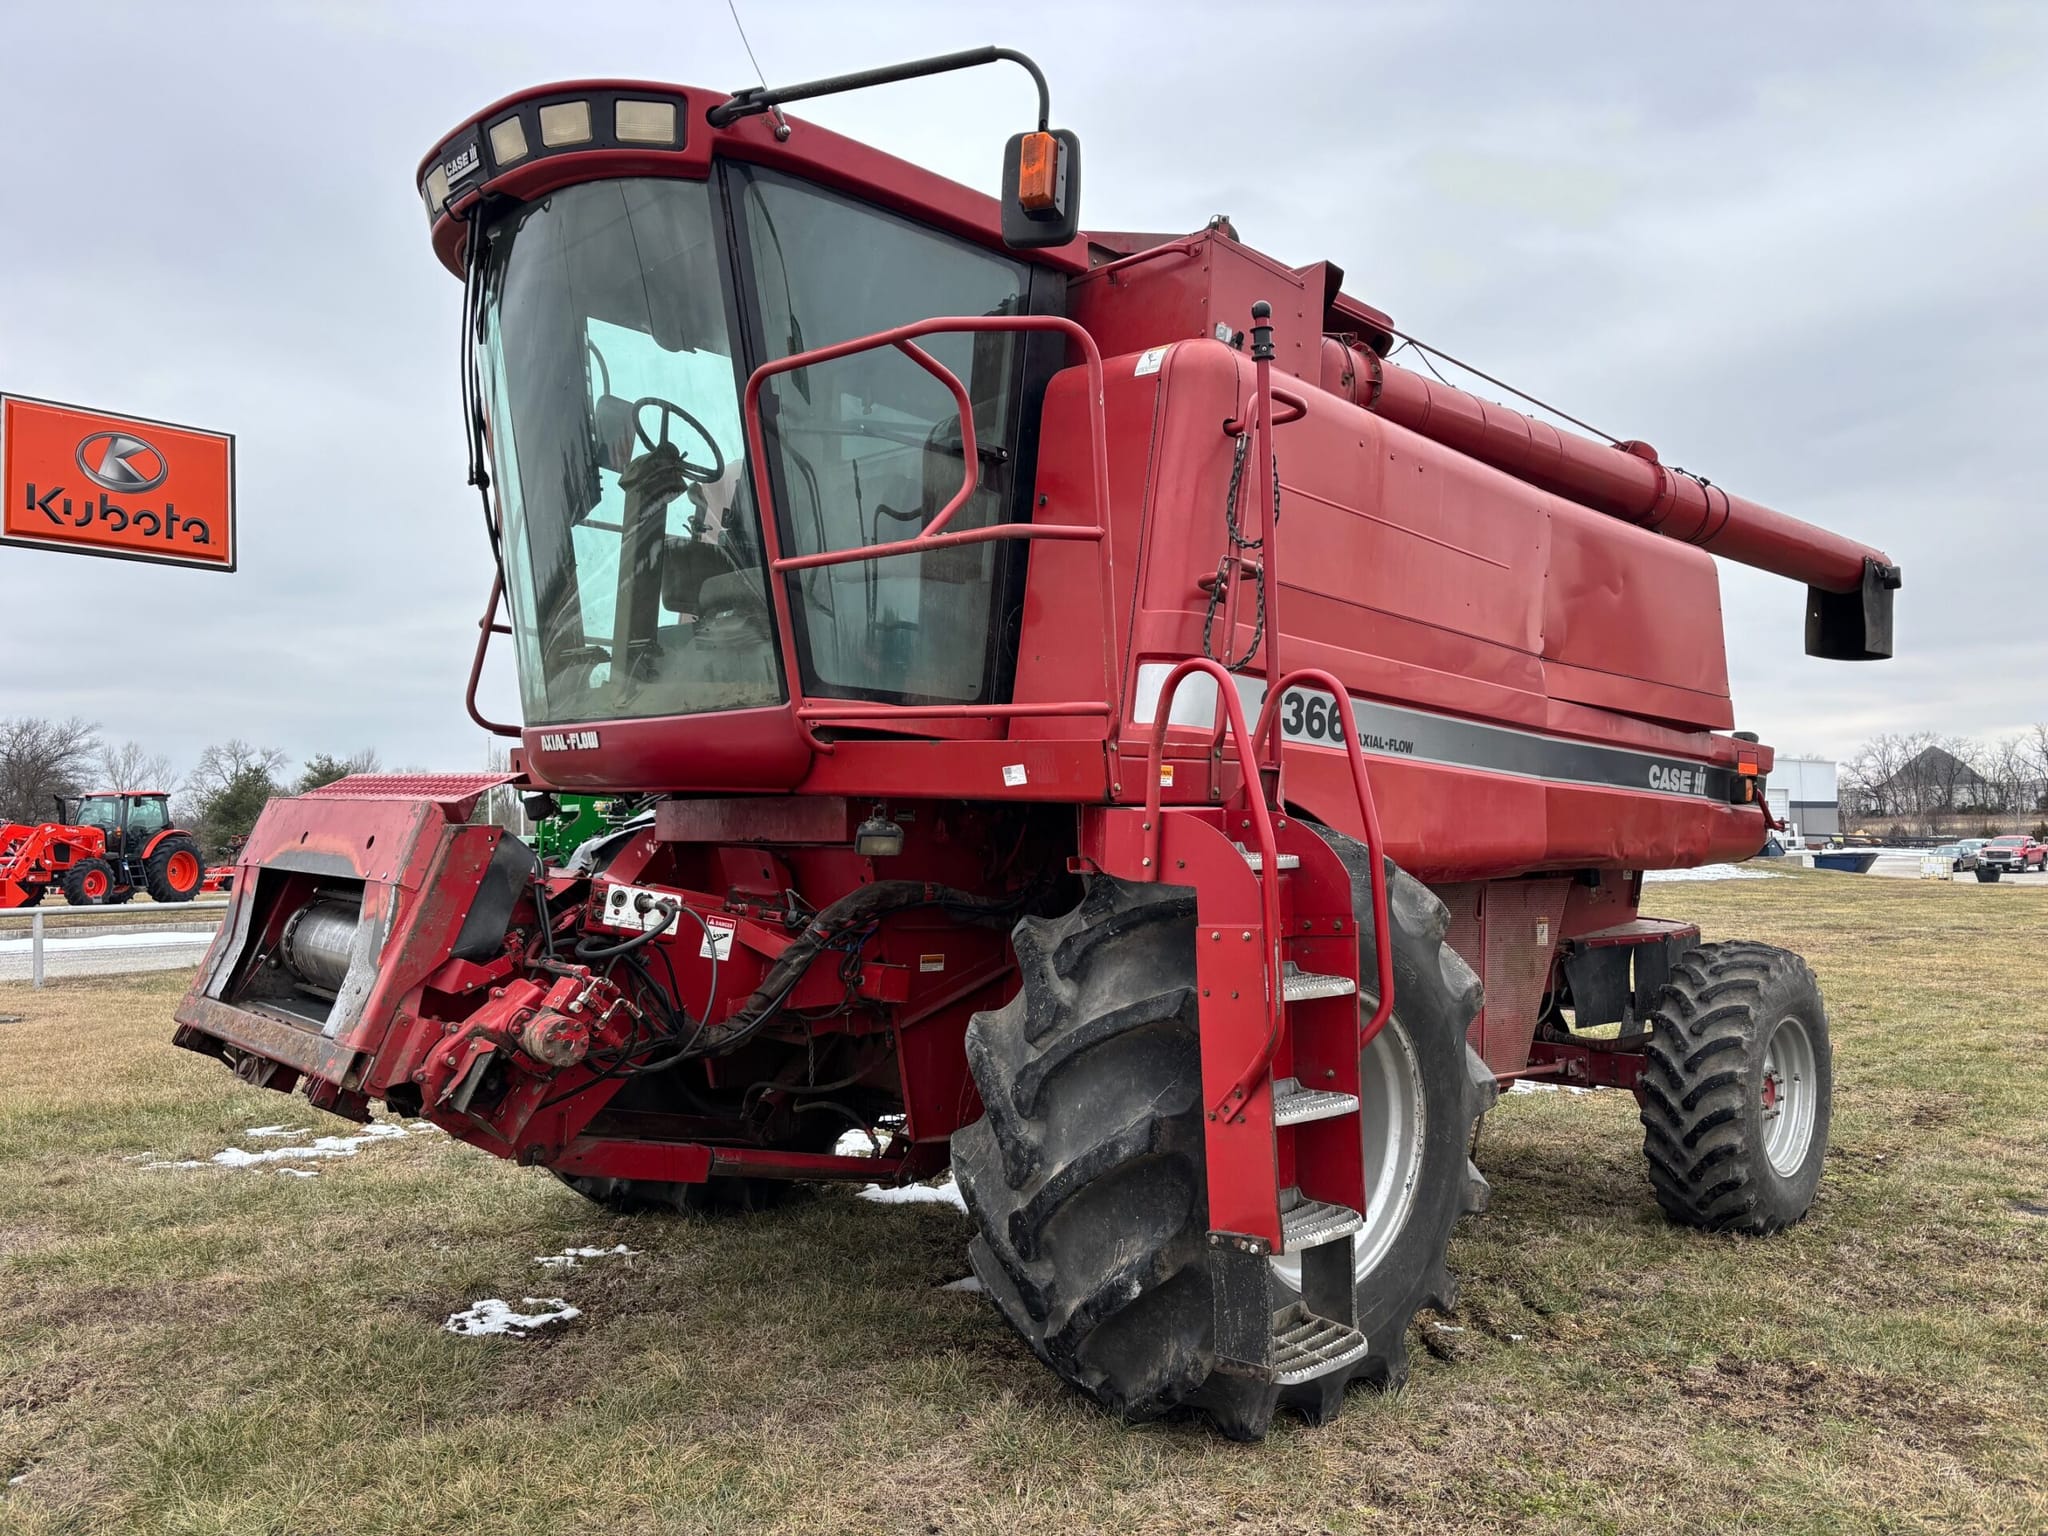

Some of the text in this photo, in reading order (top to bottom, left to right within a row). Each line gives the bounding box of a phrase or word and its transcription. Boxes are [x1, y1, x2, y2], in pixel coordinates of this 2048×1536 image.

[446, 152, 469, 177] CASE
[26, 482, 211, 545] Kubota
[1261, 689, 1345, 743] 366
[1649, 764, 1692, 793] CASE
